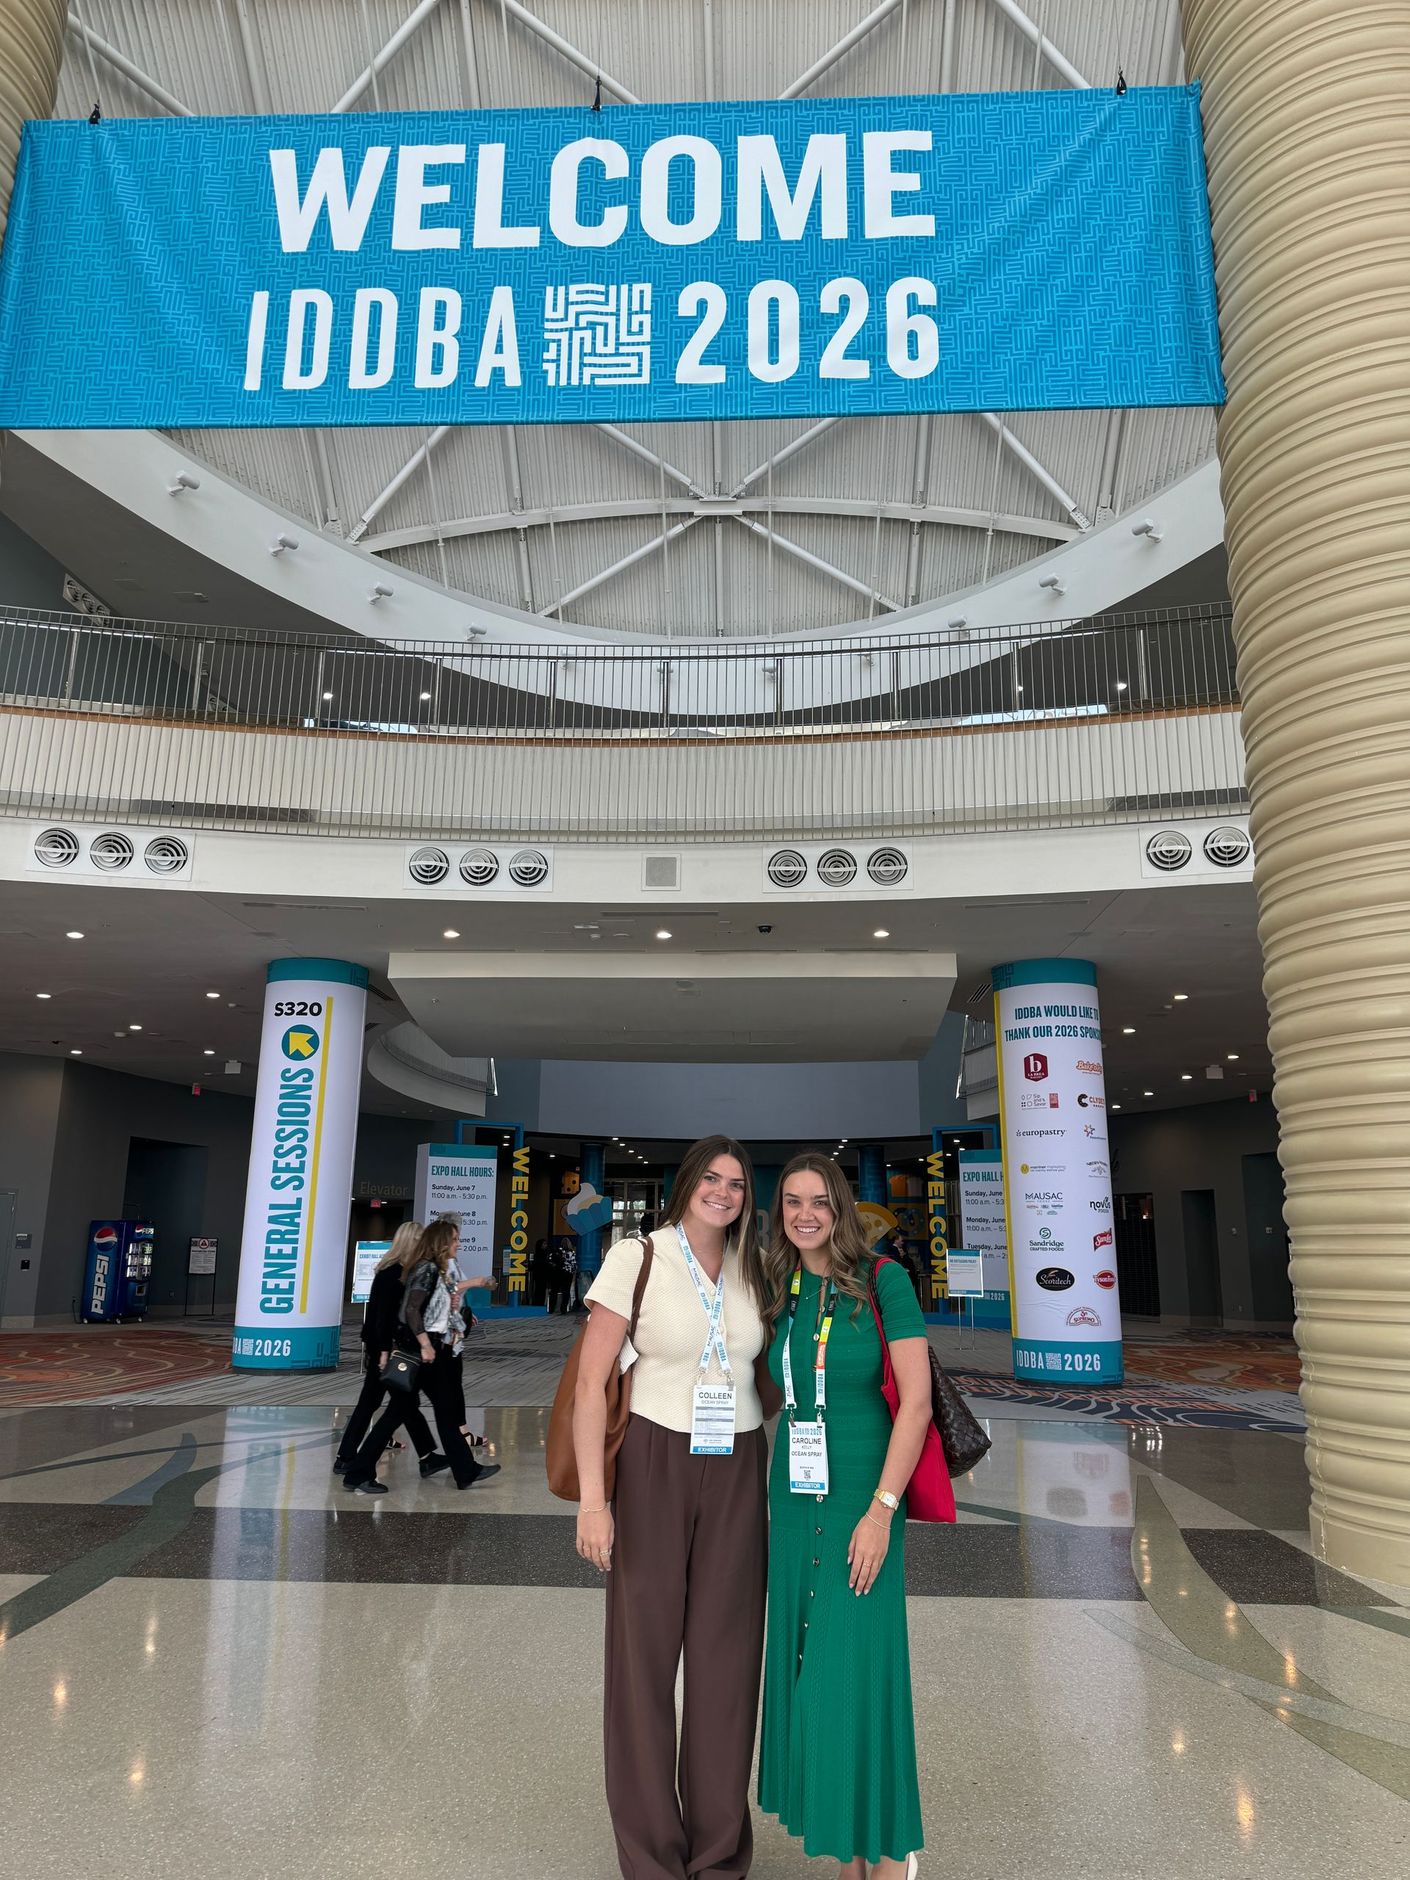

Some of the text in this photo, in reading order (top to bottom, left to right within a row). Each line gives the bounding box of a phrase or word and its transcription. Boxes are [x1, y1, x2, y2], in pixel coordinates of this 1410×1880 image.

[269, 130, 935, 252] WELCOME
[244, 276, 940, 391] IDDBA 2026
[274, 1001, 322, 1017] S320
[1014, 1006, 1042, 1020] IDDBA
[1044, 1005, 1077, 1018] WOULD
[1079, 1006, 1093, 1020] LIKE
[1005, 1026, 1031, 1042] THANK
[1032, 1026, 1052, 1038] OUR
[1054, 1025, 1078, 1038] 2026
[1022, 1128, 1066, 1137] europastry
[431, 1165, 494, 1178] EXPO HALL HOURS:
[963, 1172, 980, 1182] EXPO
[981, 1171, 998, 1181] HALL
[259, 1067, 314, 1315] GENERAL SESSIONS
[360, 1181, 408, 1196] Elevator
[509, 1146, 530, 1292] WELCOME
[926, 1150, 949, 1299] WELCOME
[91, 1254, 110, 1314] PEPSI
[254, 1339, 291, 1357] 2026
[1016, 1349, 1100, 1371] IDDBA 2026
